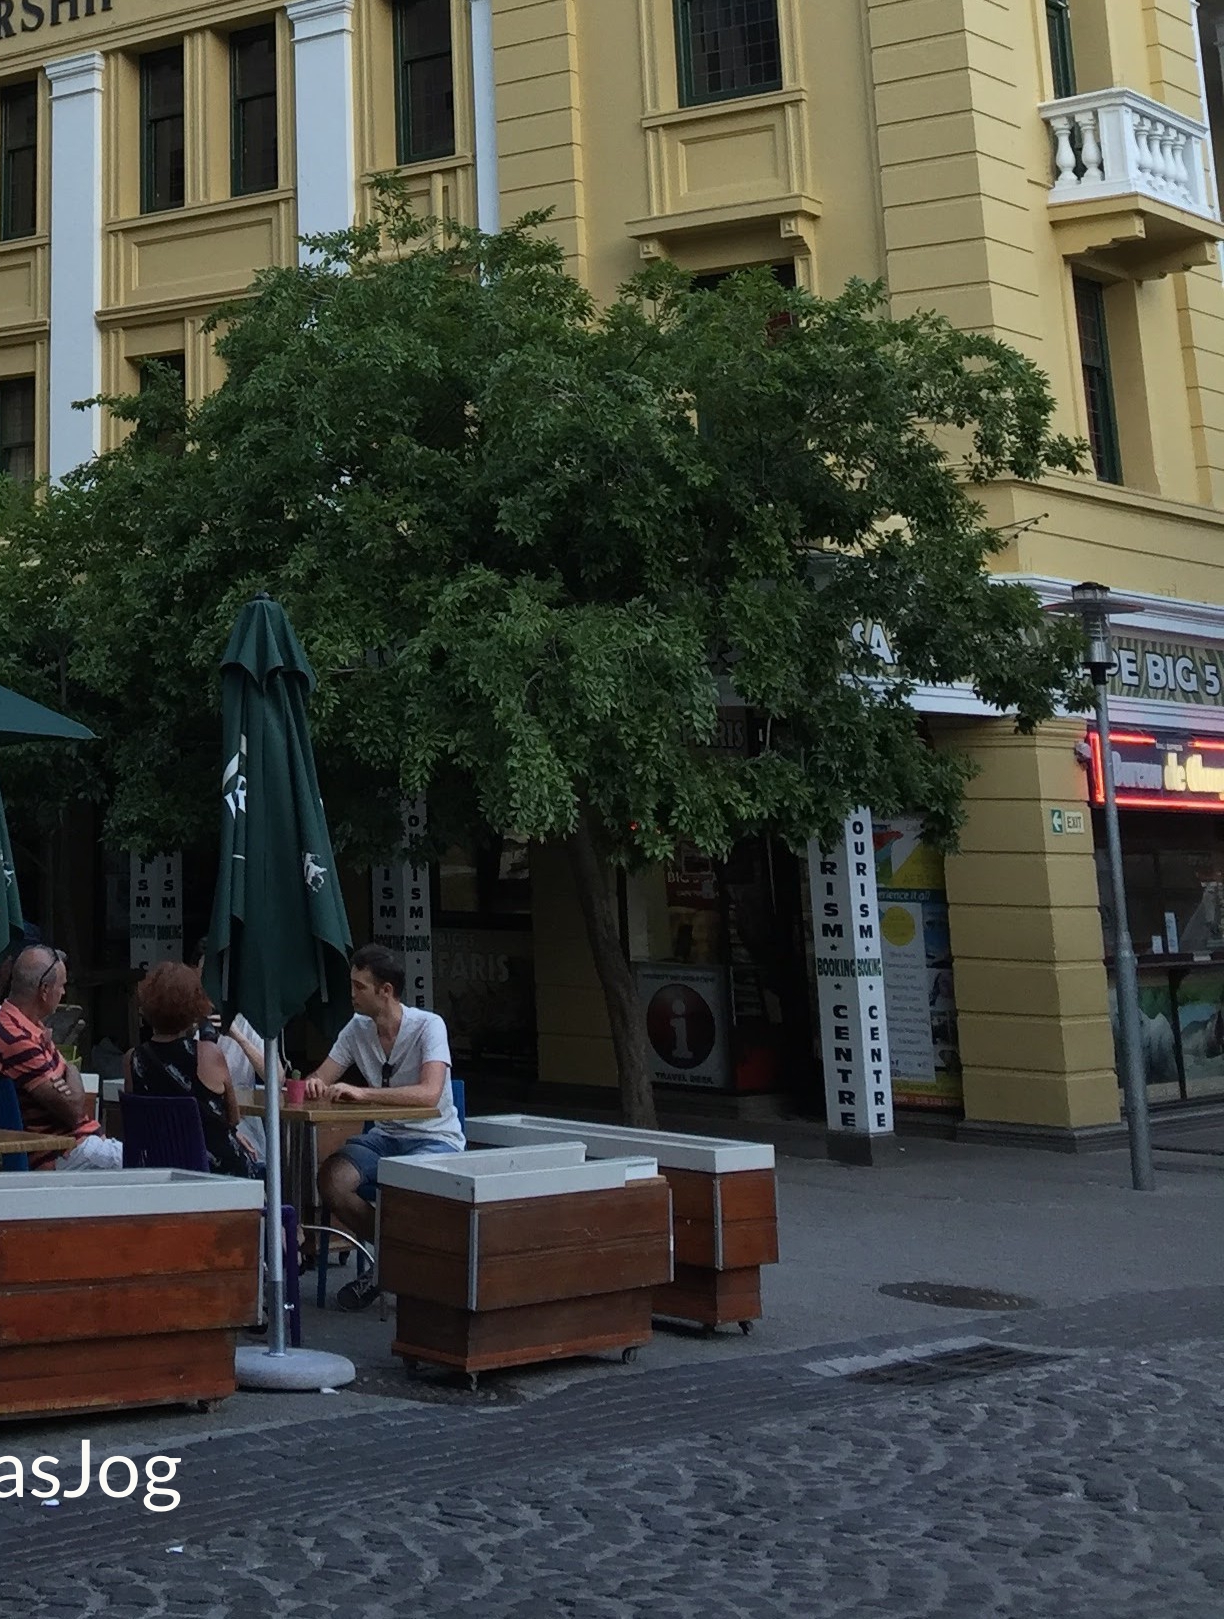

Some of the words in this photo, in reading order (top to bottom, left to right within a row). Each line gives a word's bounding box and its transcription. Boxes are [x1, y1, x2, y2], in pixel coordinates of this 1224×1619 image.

[1144, 650, 1199, 693] BIG
[1203, 662, 1221, 696] 5
[1066, 814, 1082, 831] EXIT
[820, 861, 844, 939] RISM
[438, 950, 510, 982] FARIS
[817, 957, 856, 978] BOOKING
[857, 957, 883, 978] BOOKING
[832, 1003, 856, 1128] CENTRE
[868, 1004, 887, 1129] CENTRE
